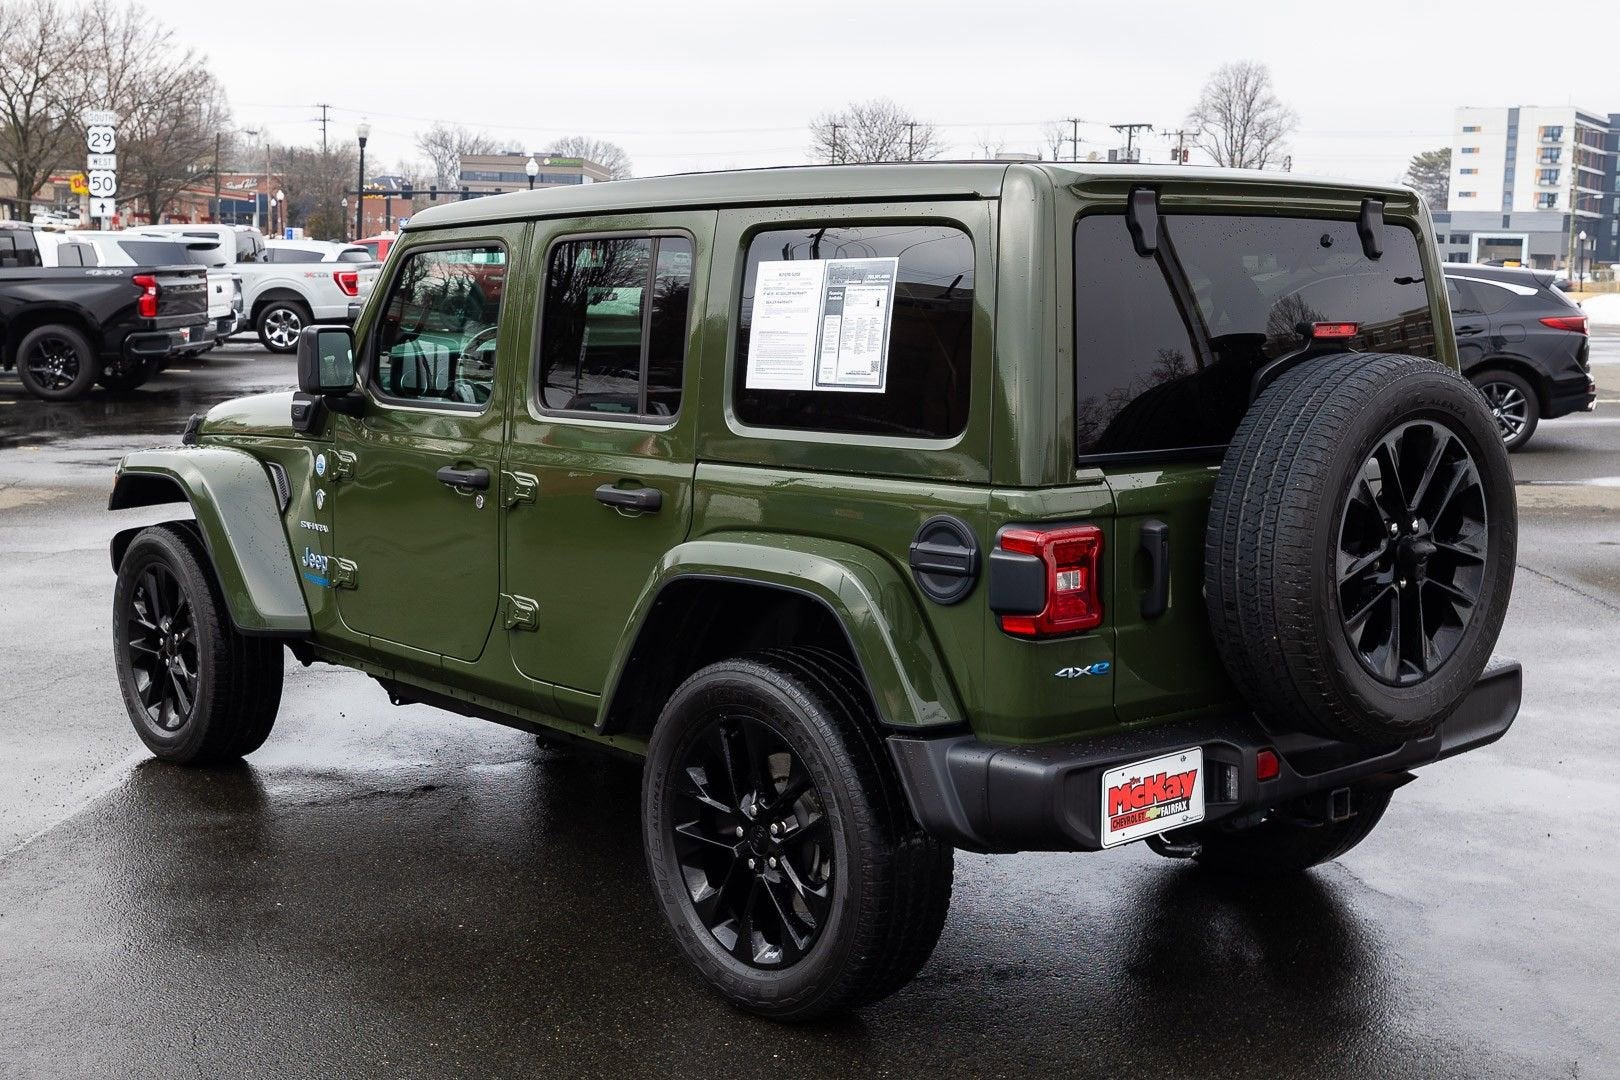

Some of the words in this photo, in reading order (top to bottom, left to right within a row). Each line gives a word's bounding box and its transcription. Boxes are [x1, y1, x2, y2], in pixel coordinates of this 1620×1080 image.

[89, 112, 114, 122] SOUTH
[91, 132, 112, 147] 29
[93, 158, 111, 166] WEST
[92, 177, 112, 191] 50
[302, 547, 328, 574] Jeep
[1108, 769, 1197, 817] McKay
[1160, 801, 1188, 817] FAIRFAX
[1112, 811, 1146, 829] CHEVROLET
